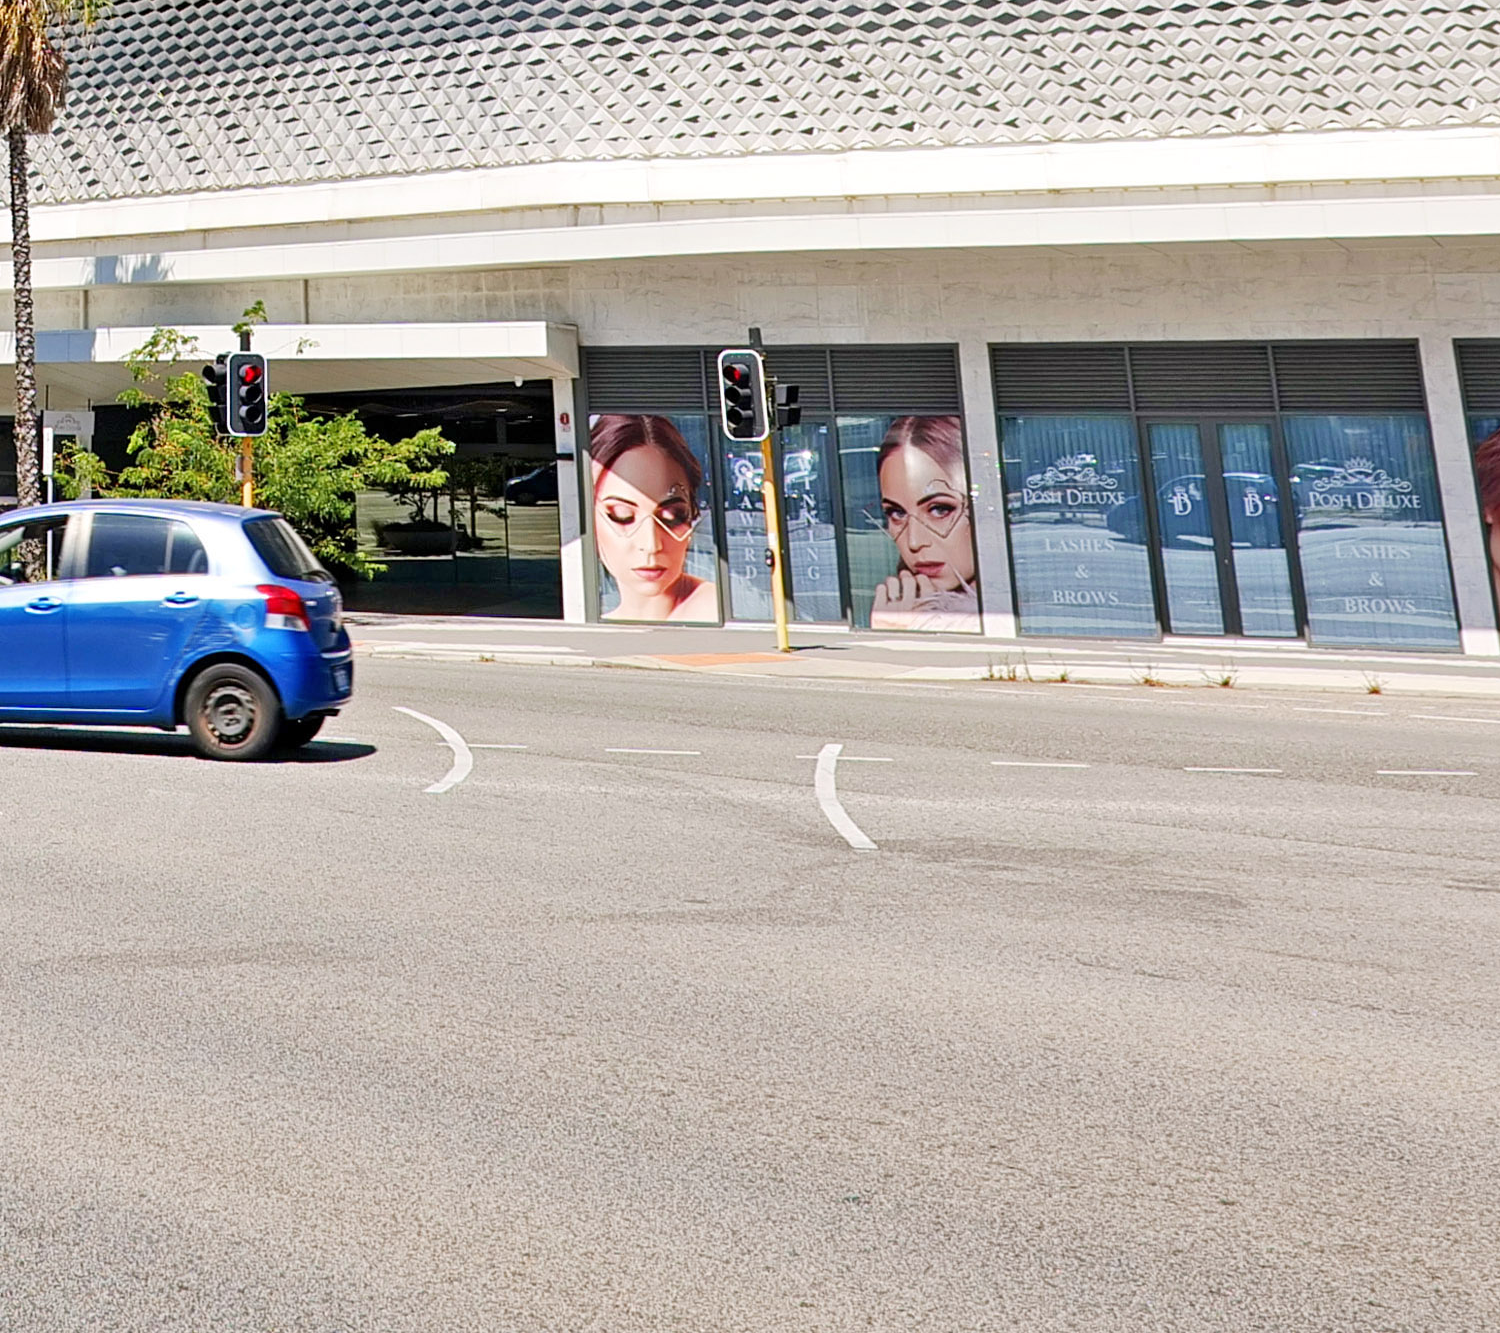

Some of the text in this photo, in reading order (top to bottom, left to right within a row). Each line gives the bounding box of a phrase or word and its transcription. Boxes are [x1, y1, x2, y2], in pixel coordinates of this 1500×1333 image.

[1022, 488, 1062, 505] POSH
[1308, 491, 1352, 508] POSH
[1045, 537, 1115, 553] LASHES
[1335, 544, 1411, 559] LASHES
[1053, 589, 1119, 605] BROWS
[1344, 598, 1416, 614] BROWS
